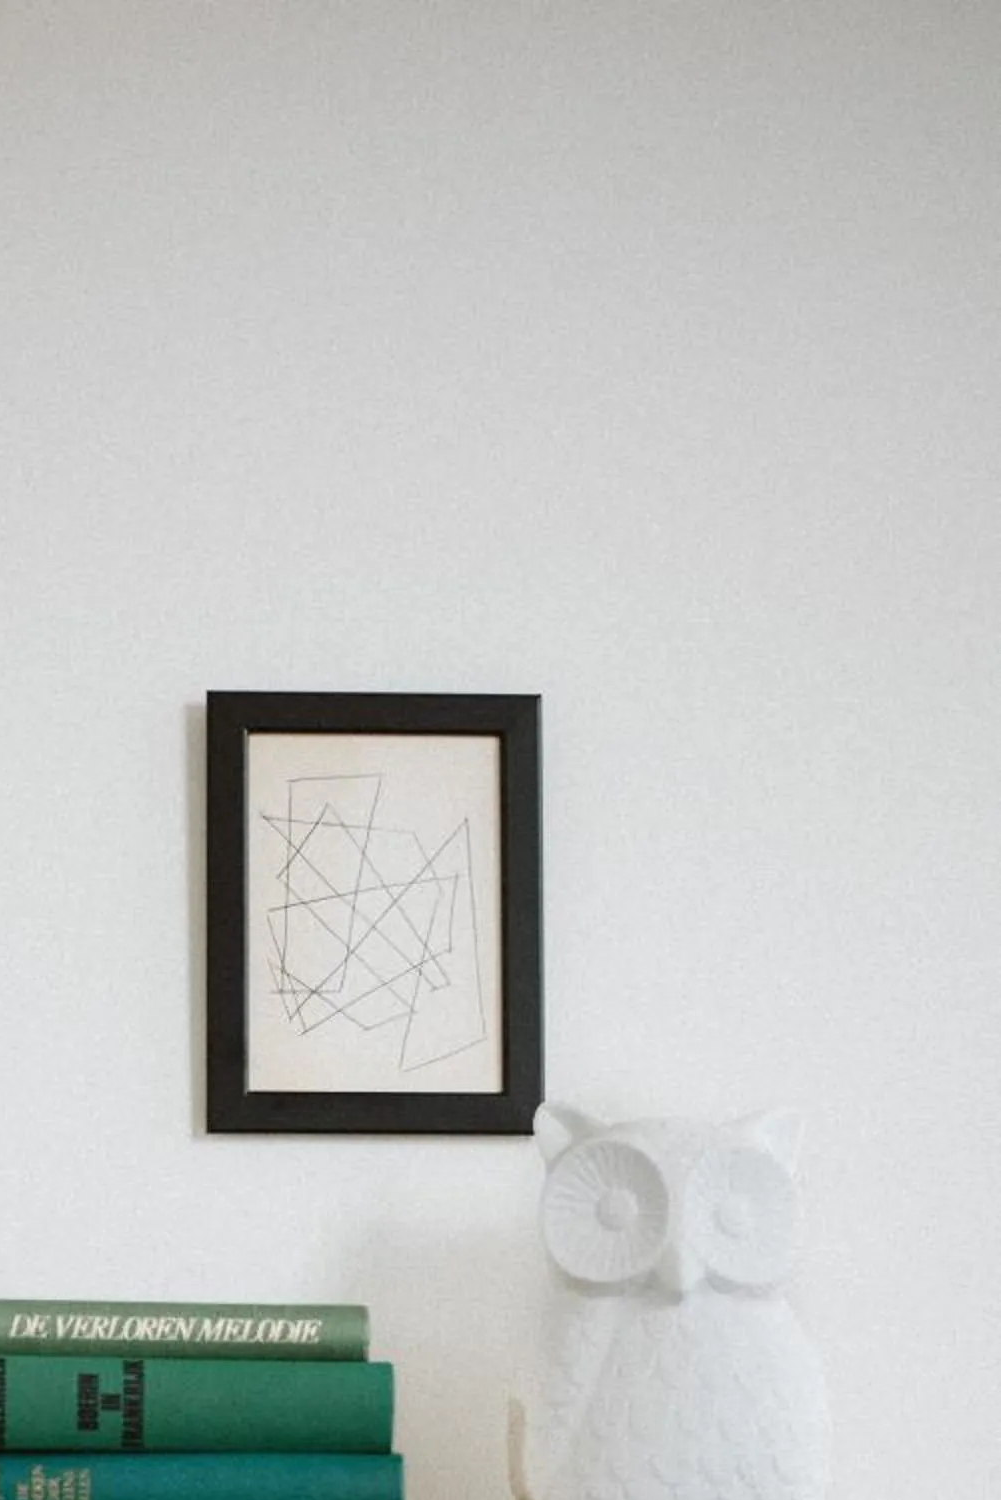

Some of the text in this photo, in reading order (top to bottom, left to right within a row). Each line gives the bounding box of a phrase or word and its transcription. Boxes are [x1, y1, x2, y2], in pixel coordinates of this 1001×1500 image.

[9, 1313, 322, 1344] DE VERLOREN MELODIE
[77, 1373, 98, 1431] BOERIN
[101, 1393, 121, 1411] IN
[121, 1360, 143, 1447] FRANKRIJK
